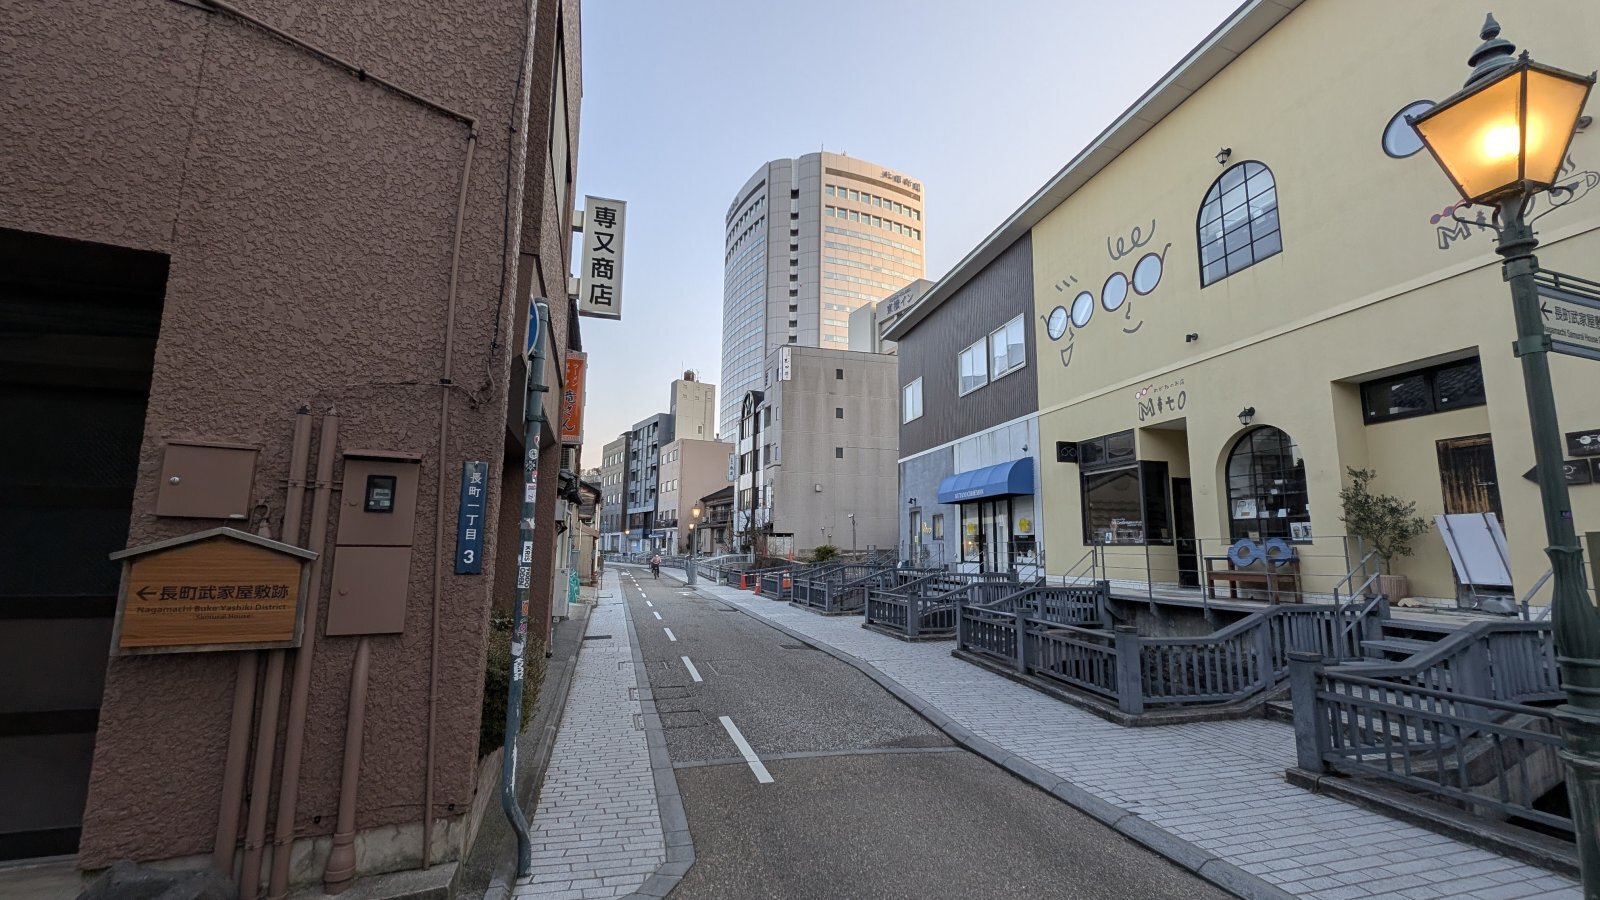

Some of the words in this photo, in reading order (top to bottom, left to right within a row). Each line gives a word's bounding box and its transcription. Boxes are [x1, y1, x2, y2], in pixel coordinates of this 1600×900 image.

[590, 206, 617, 306] 専又商店
[466, 472, 482, 540] 長町一丁目
[463, 549, 474, 564] 3
[159, 584, 289, 600] 長町武家屋敷跡
[136, 605, 192, 614] Nagamachi
[220, 604, 252, 612] Yashiki
[255, 603, 287, 611] District
